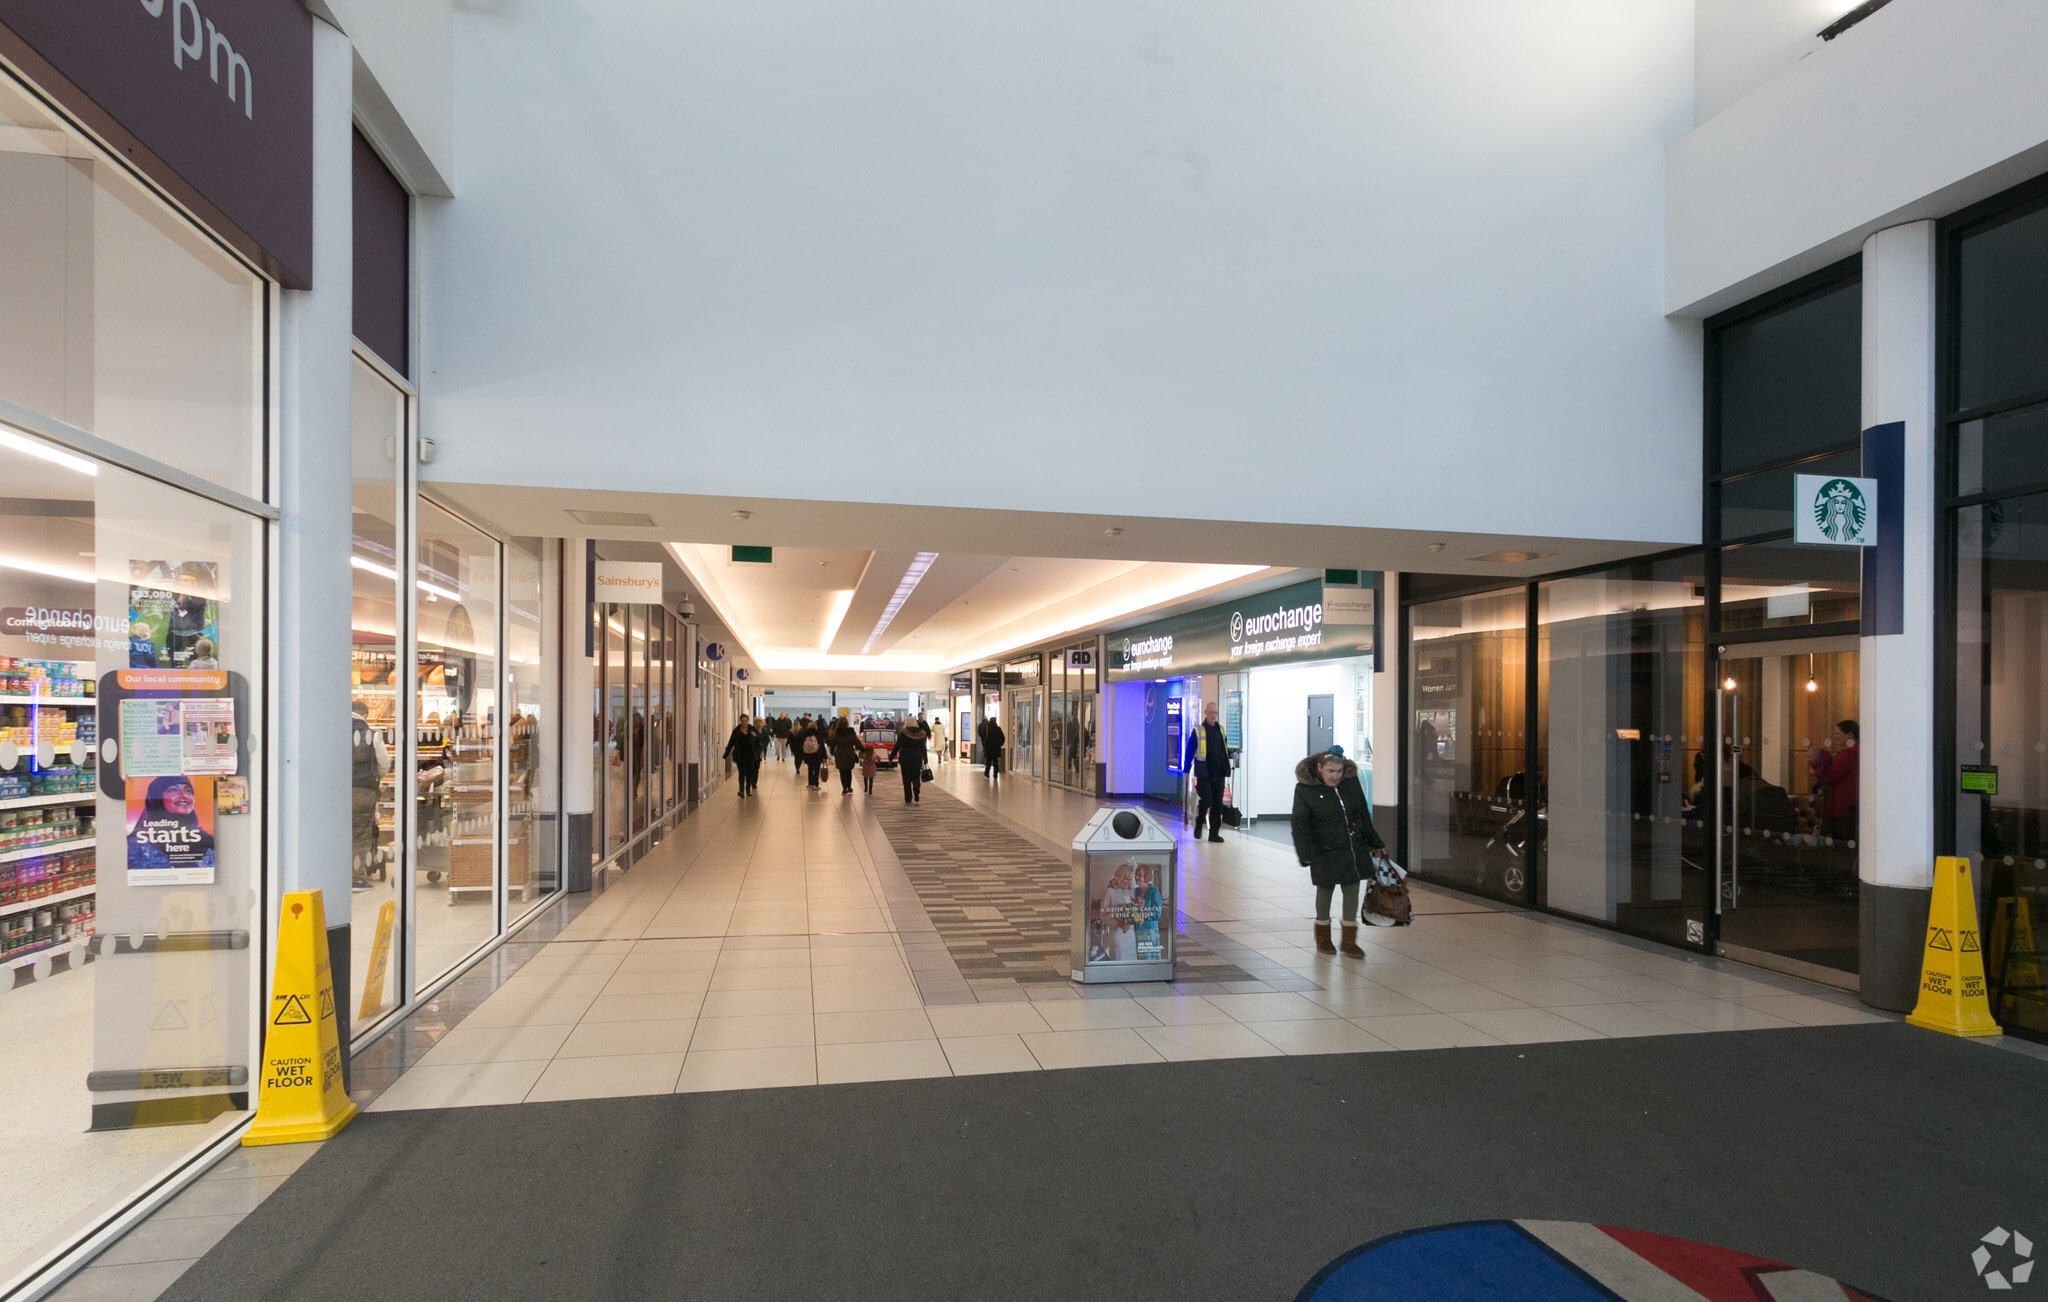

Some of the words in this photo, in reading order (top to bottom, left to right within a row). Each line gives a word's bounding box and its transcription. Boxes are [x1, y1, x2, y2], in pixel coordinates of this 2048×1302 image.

[597, 575, 660, 588] Sainsbury's
[1245, 603, 1322, 636] eurochange
[1131, 635, 1173, 656] eurochange
[1231, 645, 1244, 658] your
[1244, 640, 1264, 656] foreign
[1265, 636, 1296, 652] exchange
[1297, 630, 1321, 647] expert
[1071, 651, 1091, 664] AD
[125, 675, 142, 684] Our
[144, 674, 166, 683] local
[168, 675, 221, 685] community
[143, 819, 179, 829] Leading
[136, 826, 202, 844] starts
[165, 843, 190, 852] here
[1925, 970, 1952, 980] CAUTION
[1928, 976, 1948, 987] WET
[1965, 981, 1980, 989] WET
[1922, 983, 1953, 996] FLOOR
[1961, 989, 1985, 997] FLOOR
[270, 1057, 312, 1066] CAUTION
[276, 1065, 305, 1077] WET
[267, 1076, 313, 1089] FLOOR
